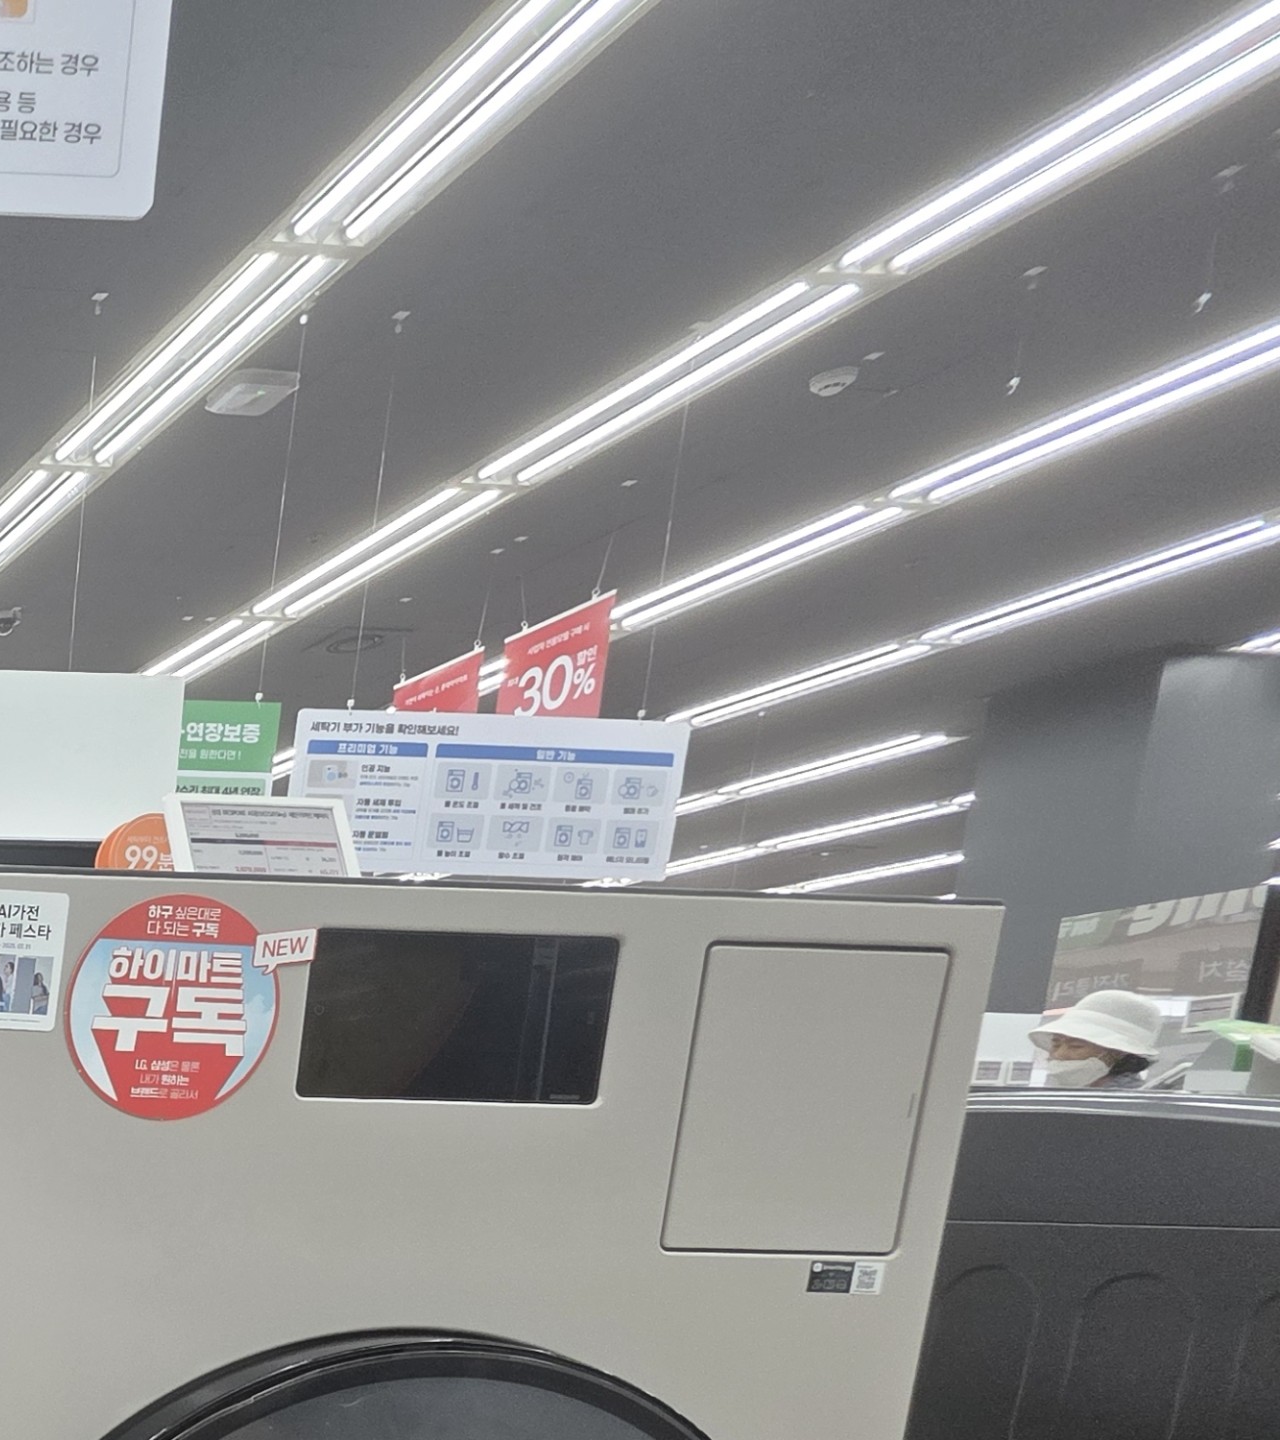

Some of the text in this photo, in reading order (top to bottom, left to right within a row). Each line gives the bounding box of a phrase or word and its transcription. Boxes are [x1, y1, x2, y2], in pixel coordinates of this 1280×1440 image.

[60, 52, 100, 77] 경우
[17, 91, 37, 114] 등
[0, 119, 58, 143] 필요한
[63, 121, 103, 146] 경우
[576, 645, 597, 666] 할인
[514, 655, 596, 717] 30%
[182, 722, 261, 743] 연장보증
[311, 721, 459, 736] 세탁기 부가 기능을 확인해보세요!
[9, 922, 52, 941] 페스타
[146, 921, 219, 938] 다 되는 구독
[262, 935, 309, 958] NEW
[109, 946, 244, 984] 하이마트
[91, 983, 247, 1057] 구독
